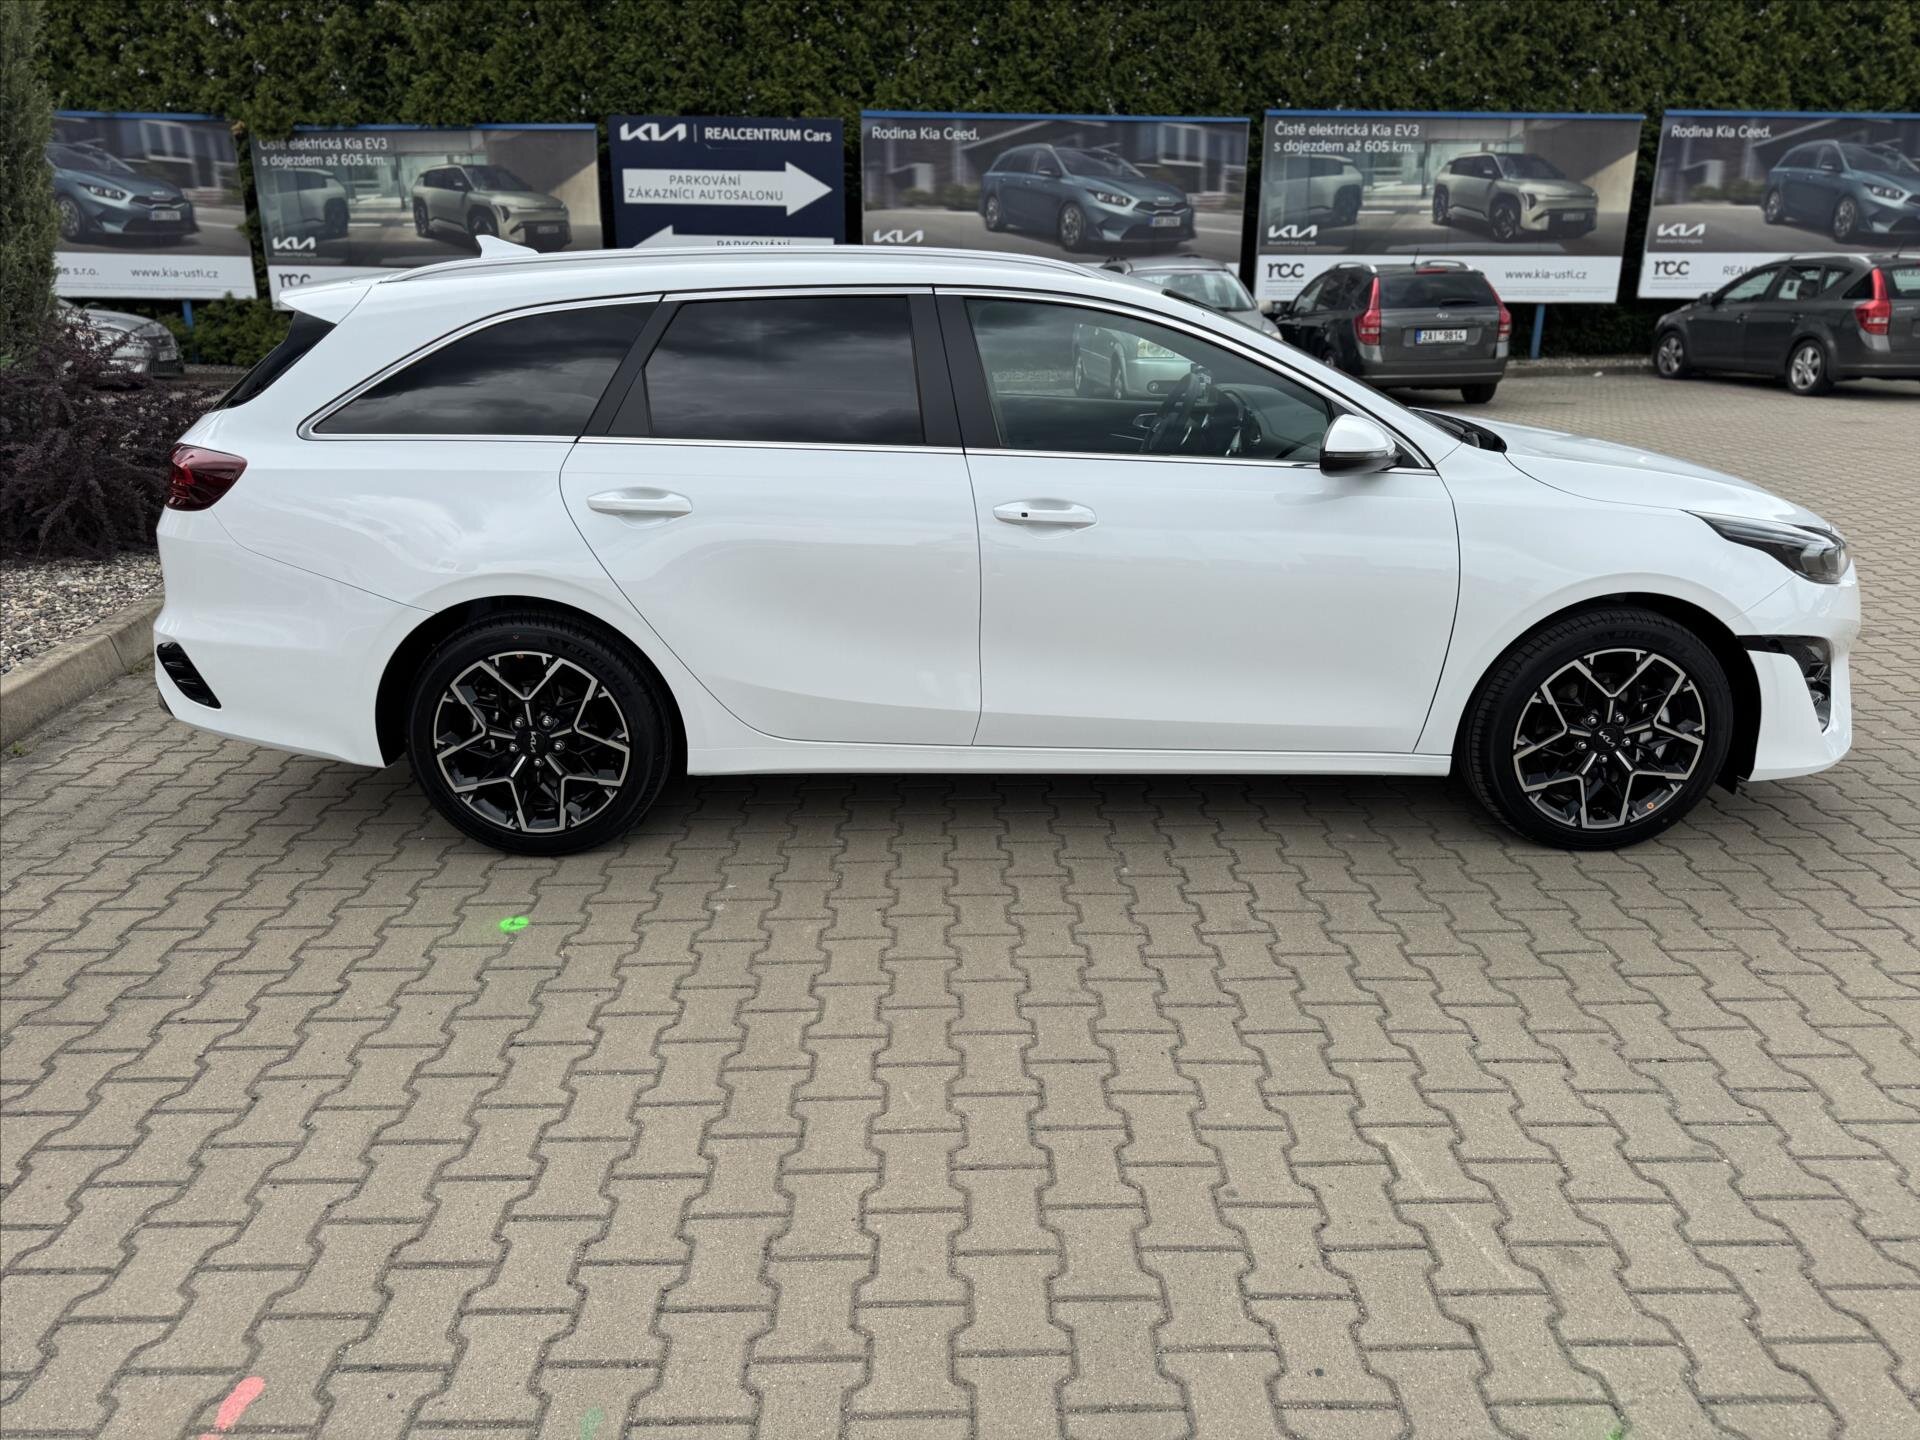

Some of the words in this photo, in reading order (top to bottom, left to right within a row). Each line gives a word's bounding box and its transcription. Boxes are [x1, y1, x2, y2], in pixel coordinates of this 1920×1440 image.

[704, 127, 801, 142] REALCENTRUM
[803, 128, 833, 142] Cars
[871, 126, 917, 140] Rodina
[920, 127, 940, 140] Kia
[943, 127, 980, 141] Ceed.
[1274, 120, 1306, 136] Čistě
[1308, 122, 1368, 136] elektrická
[1371, 124, 1391, 137] Kia
[1394, 124, 1420, 137] EV3
[1671, 124, 1713, 138] Rodina
[1716, 125, 1736, 138] Kia
[289, 137, 342, 150] elektrická
[345, 138, 362, 150] Kia
[365, 137, 388, 150] EV3
[1274, 143, 1281, 152] s
[1283, 140, 1344, 155] dojezdem
[1346, 140, 1362, 153] až
[1364, 140, 1389, 153] 605
[262, 156, 268, 166] s
[270, 154, 324, 169] dojezdem
[325, 154, 339, 166] až
[341, 154, 365, 166] 605
[669, 174, 741, 186] PARKOVÁNÍ
[628, 187, 694, 200] ZÁKAZNÍCI
[699, 189, 784, 201] AUTOSALONU
[130, 267, 219, 279] www.kia-usti.cz
[1505, 269, 1588, 280] www.kia-usti.cz
